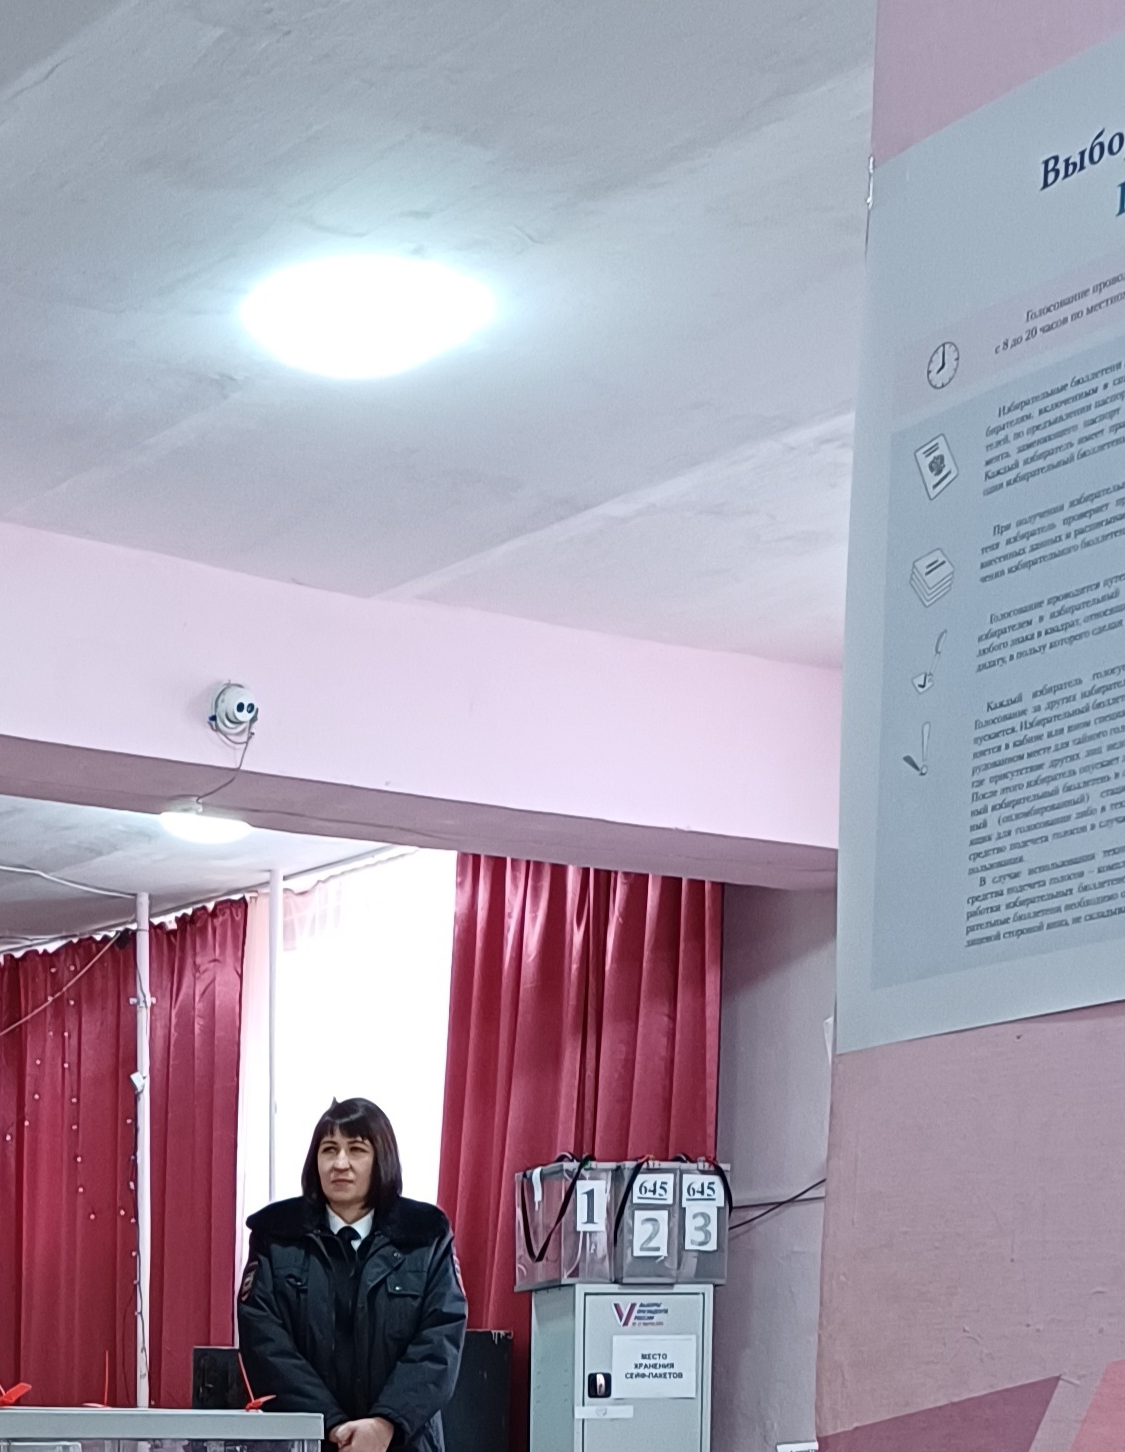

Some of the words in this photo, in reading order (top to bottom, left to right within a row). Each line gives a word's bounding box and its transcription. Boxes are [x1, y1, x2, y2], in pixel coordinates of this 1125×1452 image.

[1002, 339, 1009, 350] 8
[1010, 335, 1023, 349] до
[1025, 326, 1037, 341] 20
[1039, 316, 1068, 333] часов
[1071, 309, 1083, 321] по
[998, 383, 1067, 417] Избирательные
[992, 522, 1011, 536] При
[639, 1180, 668, 1196] 645
[687, 1181, 716, 1197] 645
[580, 1188, 598, 1224] 1
[639, 1217, 661, 1251] 2
[690, 1212, 712, 1246] 3
[625, 1371, 683, 1379] СЕЙФ-ПАКЕТОВ
